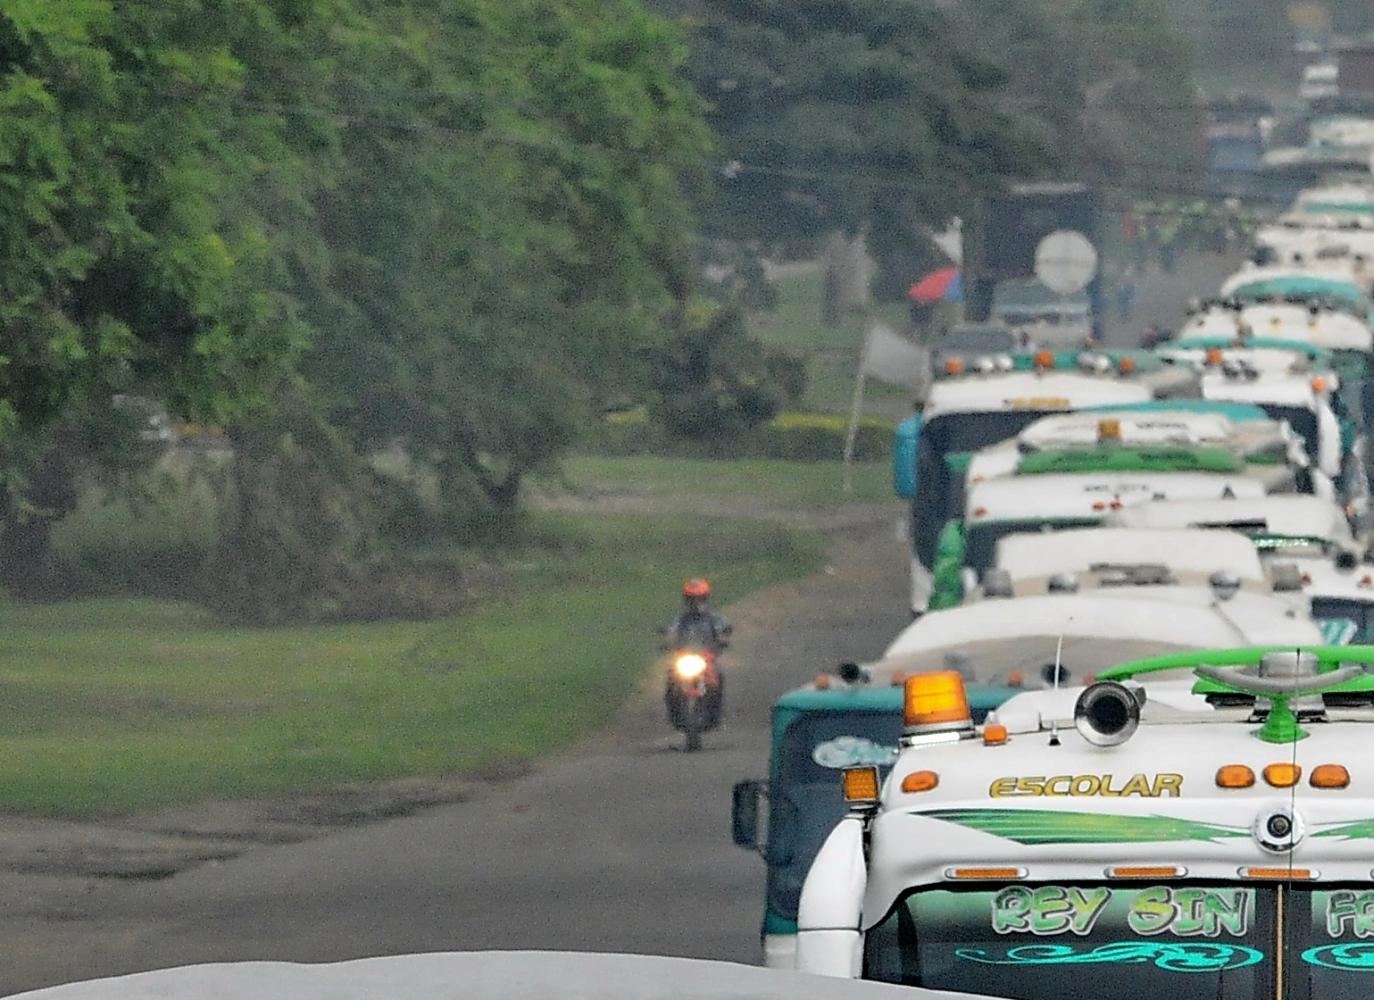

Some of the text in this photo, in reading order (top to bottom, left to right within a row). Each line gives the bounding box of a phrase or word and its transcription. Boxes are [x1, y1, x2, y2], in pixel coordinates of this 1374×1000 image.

[989, 774, 1184, 798] ESCOLAR
[992, 885, 1112, 937] REY
[1127, 886, 1250, 938] SIN
